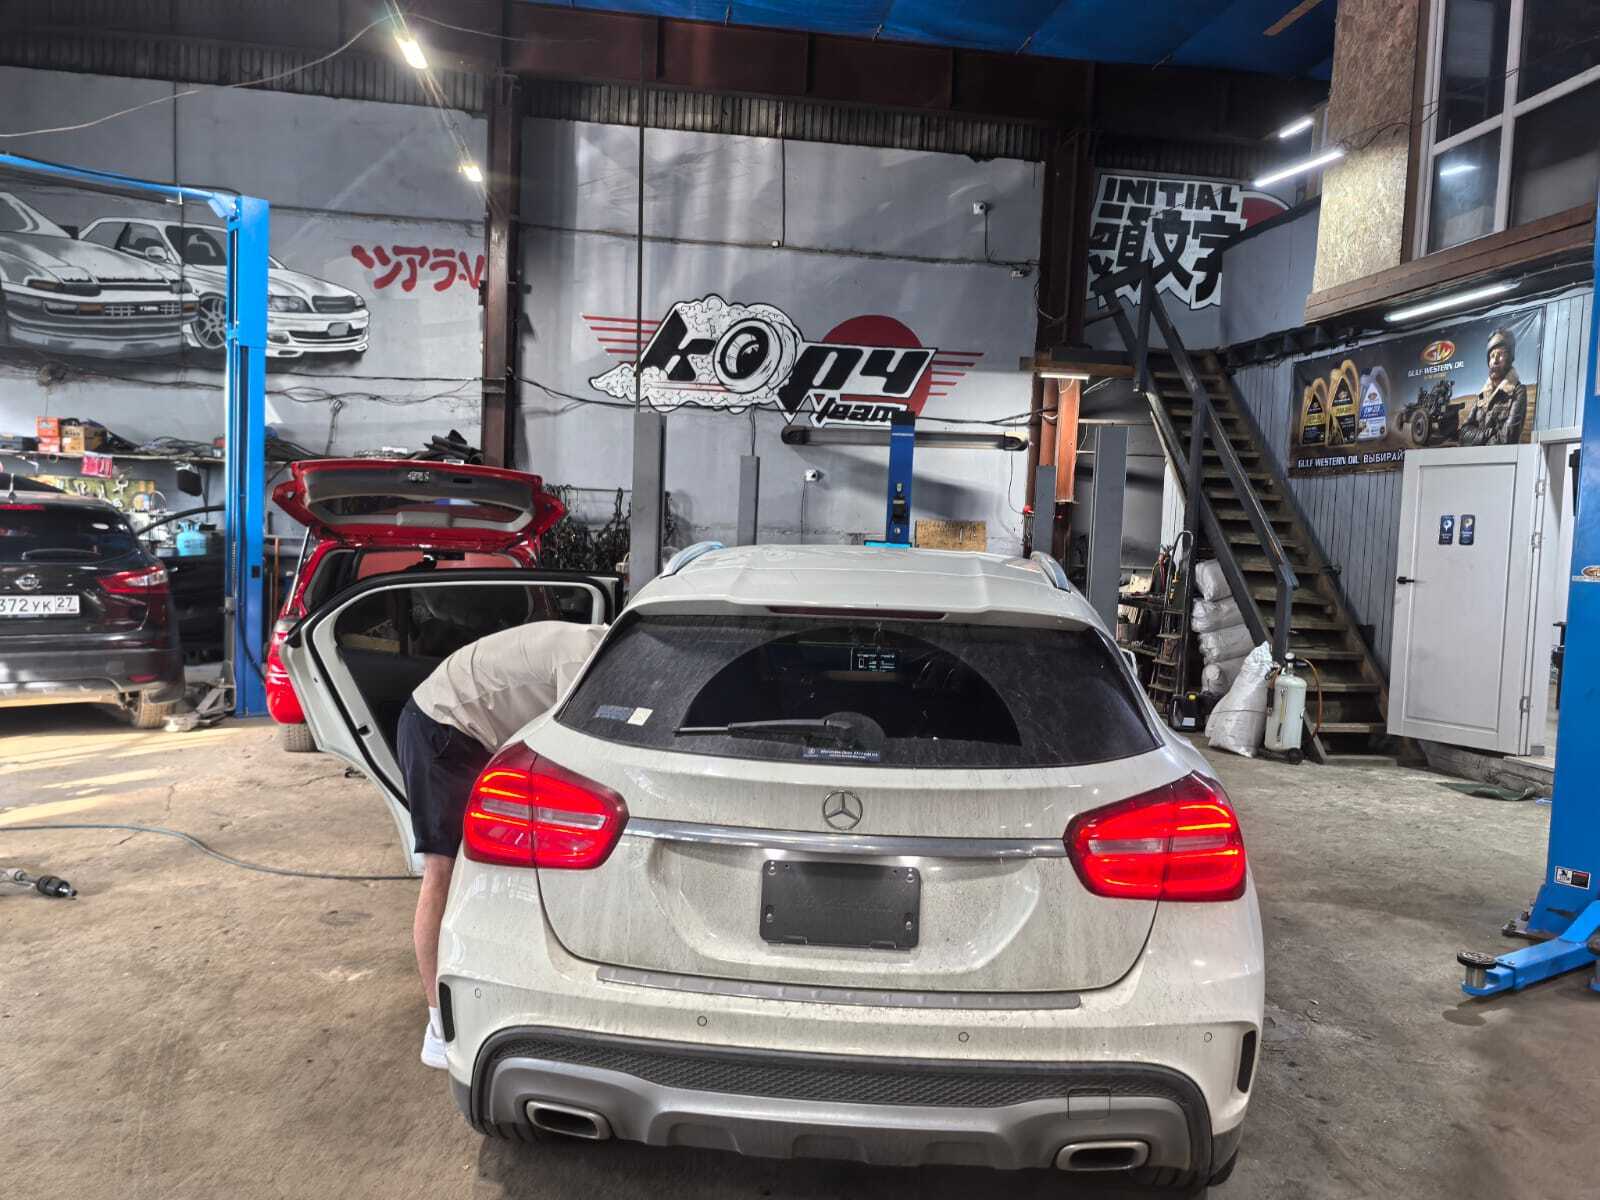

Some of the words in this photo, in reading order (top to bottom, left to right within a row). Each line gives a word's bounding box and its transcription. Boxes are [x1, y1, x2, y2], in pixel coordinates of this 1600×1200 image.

[1102, 177, 1239, 213] INITIAL
[1424, 362, 1453, 375] WESTERN
[1454, 360, 1465, 369] OIL
[1315, 456, 1346, 467] WESTERN
[57, 596, 73, 608] 27
